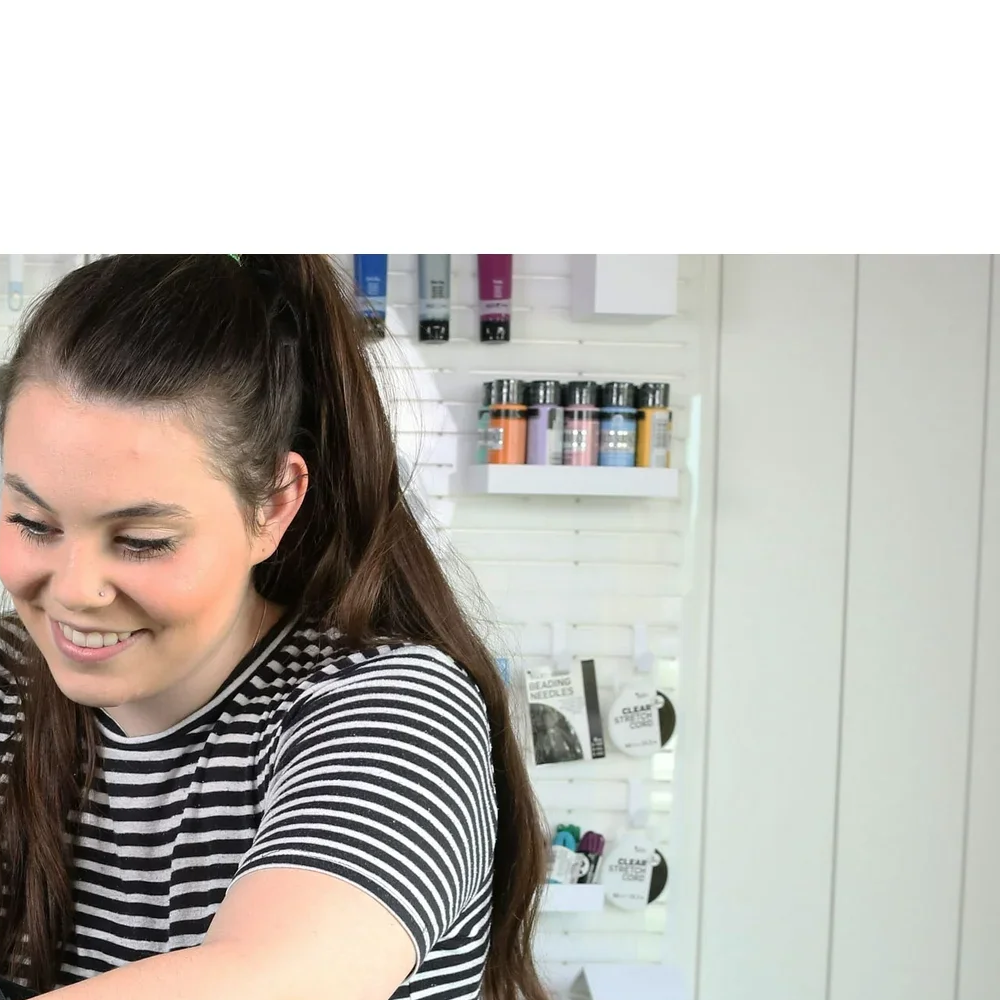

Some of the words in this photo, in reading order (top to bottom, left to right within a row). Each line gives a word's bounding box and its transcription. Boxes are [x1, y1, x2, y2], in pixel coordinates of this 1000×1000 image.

[621, 704, 652, 715] CLEAR
[614, 712, 653, 724] STRETCH
[617, 858, 647, 866] CLEAR
